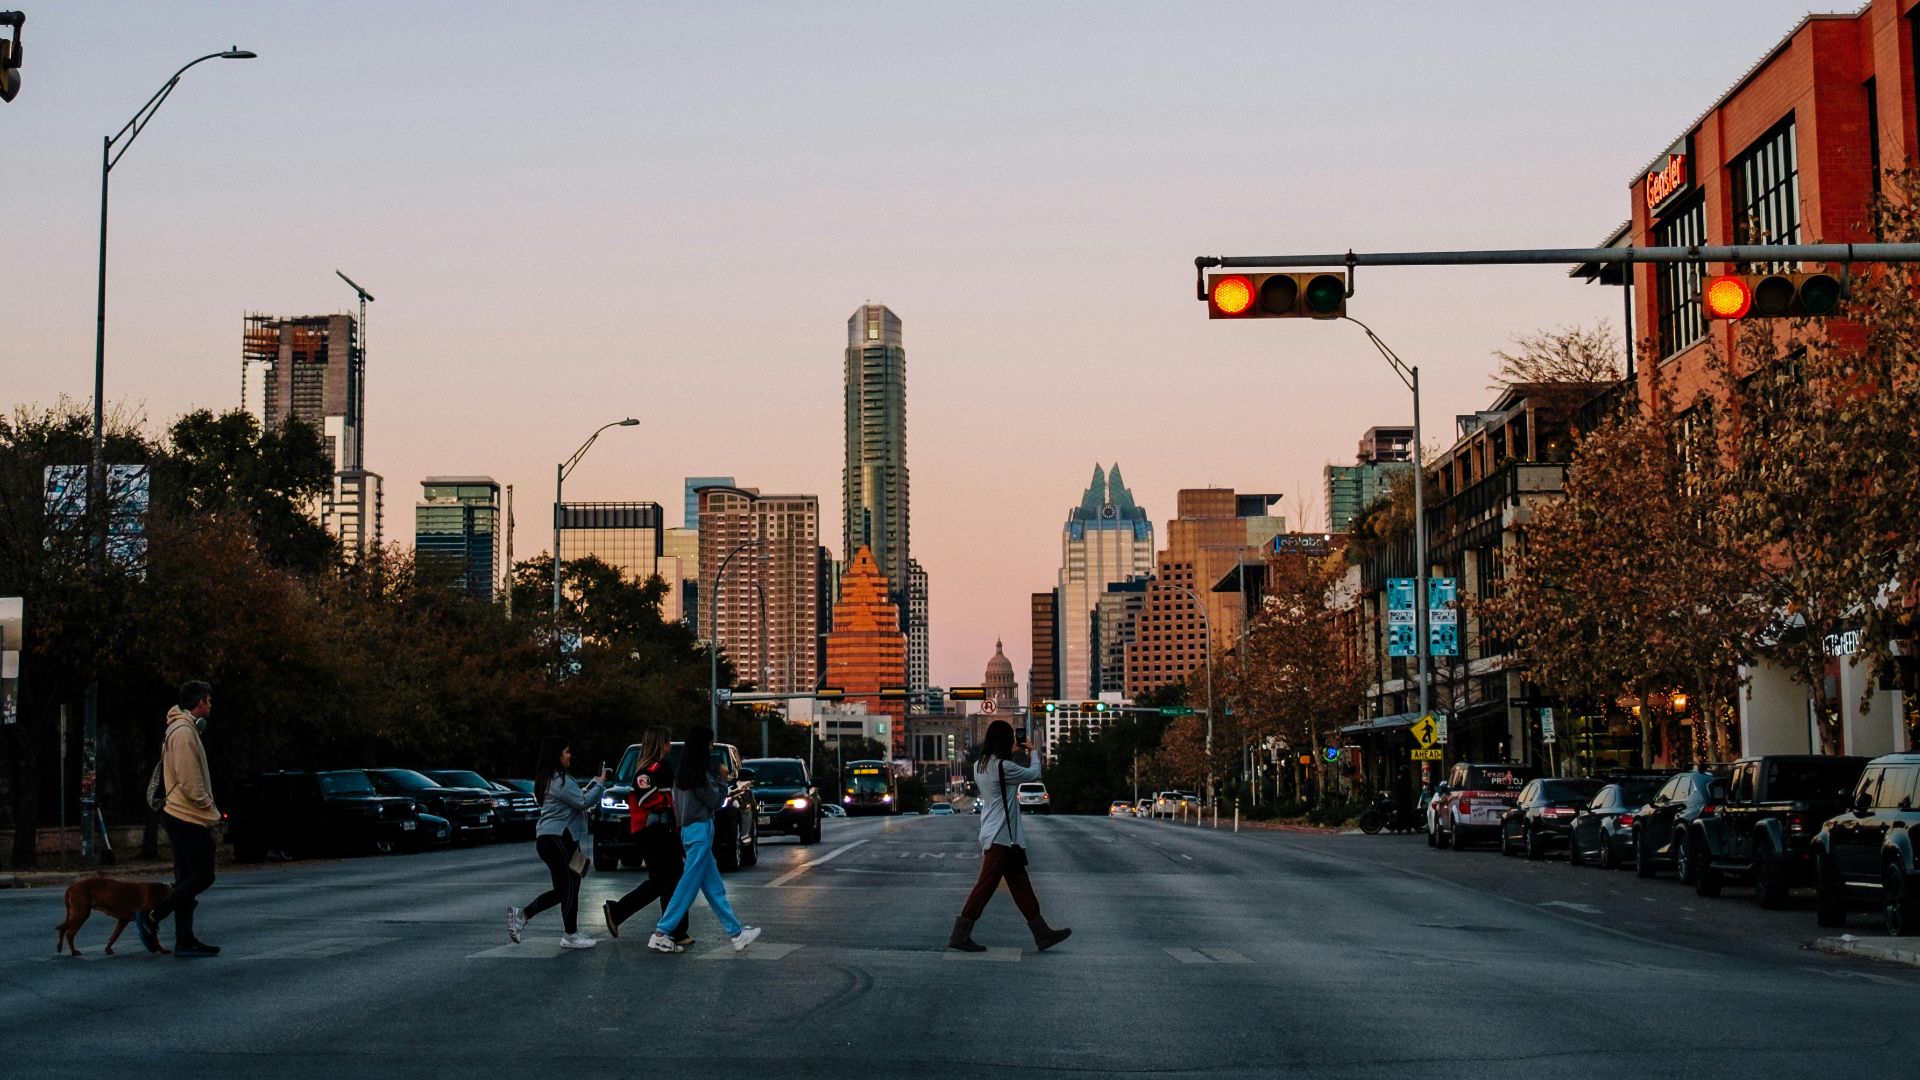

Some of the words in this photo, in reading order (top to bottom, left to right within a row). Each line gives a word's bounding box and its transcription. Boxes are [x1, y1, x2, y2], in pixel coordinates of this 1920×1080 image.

[1647, 154, 1682, 208] Gensler
[1414, 750, 1440, 759] AHEAD
[1481, 769, 1505, 777] Texas
